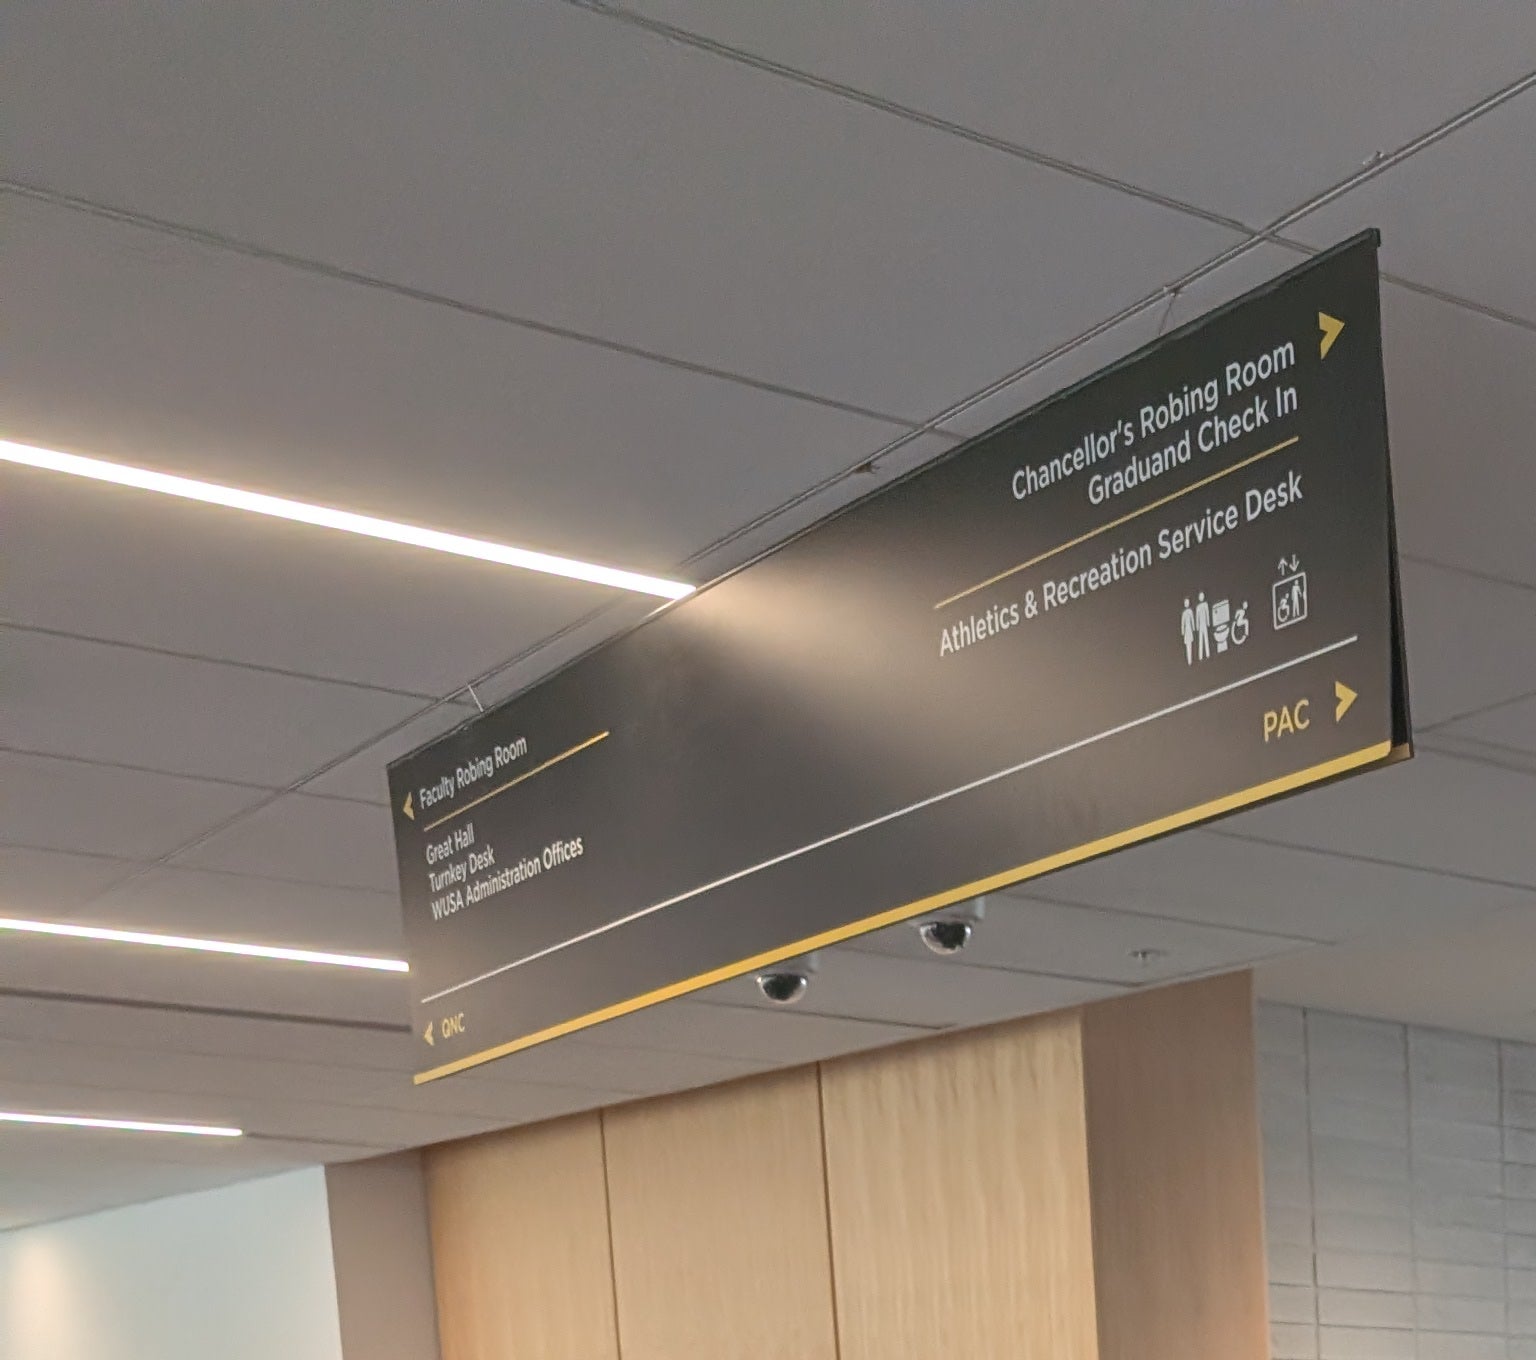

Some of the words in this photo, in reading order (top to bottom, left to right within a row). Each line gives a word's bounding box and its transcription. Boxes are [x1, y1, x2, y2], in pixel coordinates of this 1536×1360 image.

[1011, 419, 1134, 500] Chancellor's
[1139, 378, 1219, 438] Robing
[1225, 341, 1296, 396] Room
[1087, 429, 1192, 505] Graduand
[1197, 395, 1269, 452] Check
[1275, 385, 1298, 418] In
[939, 602, 1020, 657] Athletics
[1024, 589, 1038, 619] &
[1042, 543, 1152, 611] Recreation
[1158, 505, 1238, 559] Service
[1245, 470, 1303, 521] Desk
[1263, 698, 1310, 743] PAC
[419, 777, 455, 810] Faculty
[456, 754, 494, 789] Robing
[494, 736, 528, 769] Room
[426, 835, 454, 865] Great
[454, 822, 475, 850] Hall
[428, 859, 467, 892] Turnkey
[468, 843, 496, 875] Desk
[431, 889, 465, 921] WUSA
[466, 856, 542, 907] Administration
[543, 837, 584, 870] Offices
